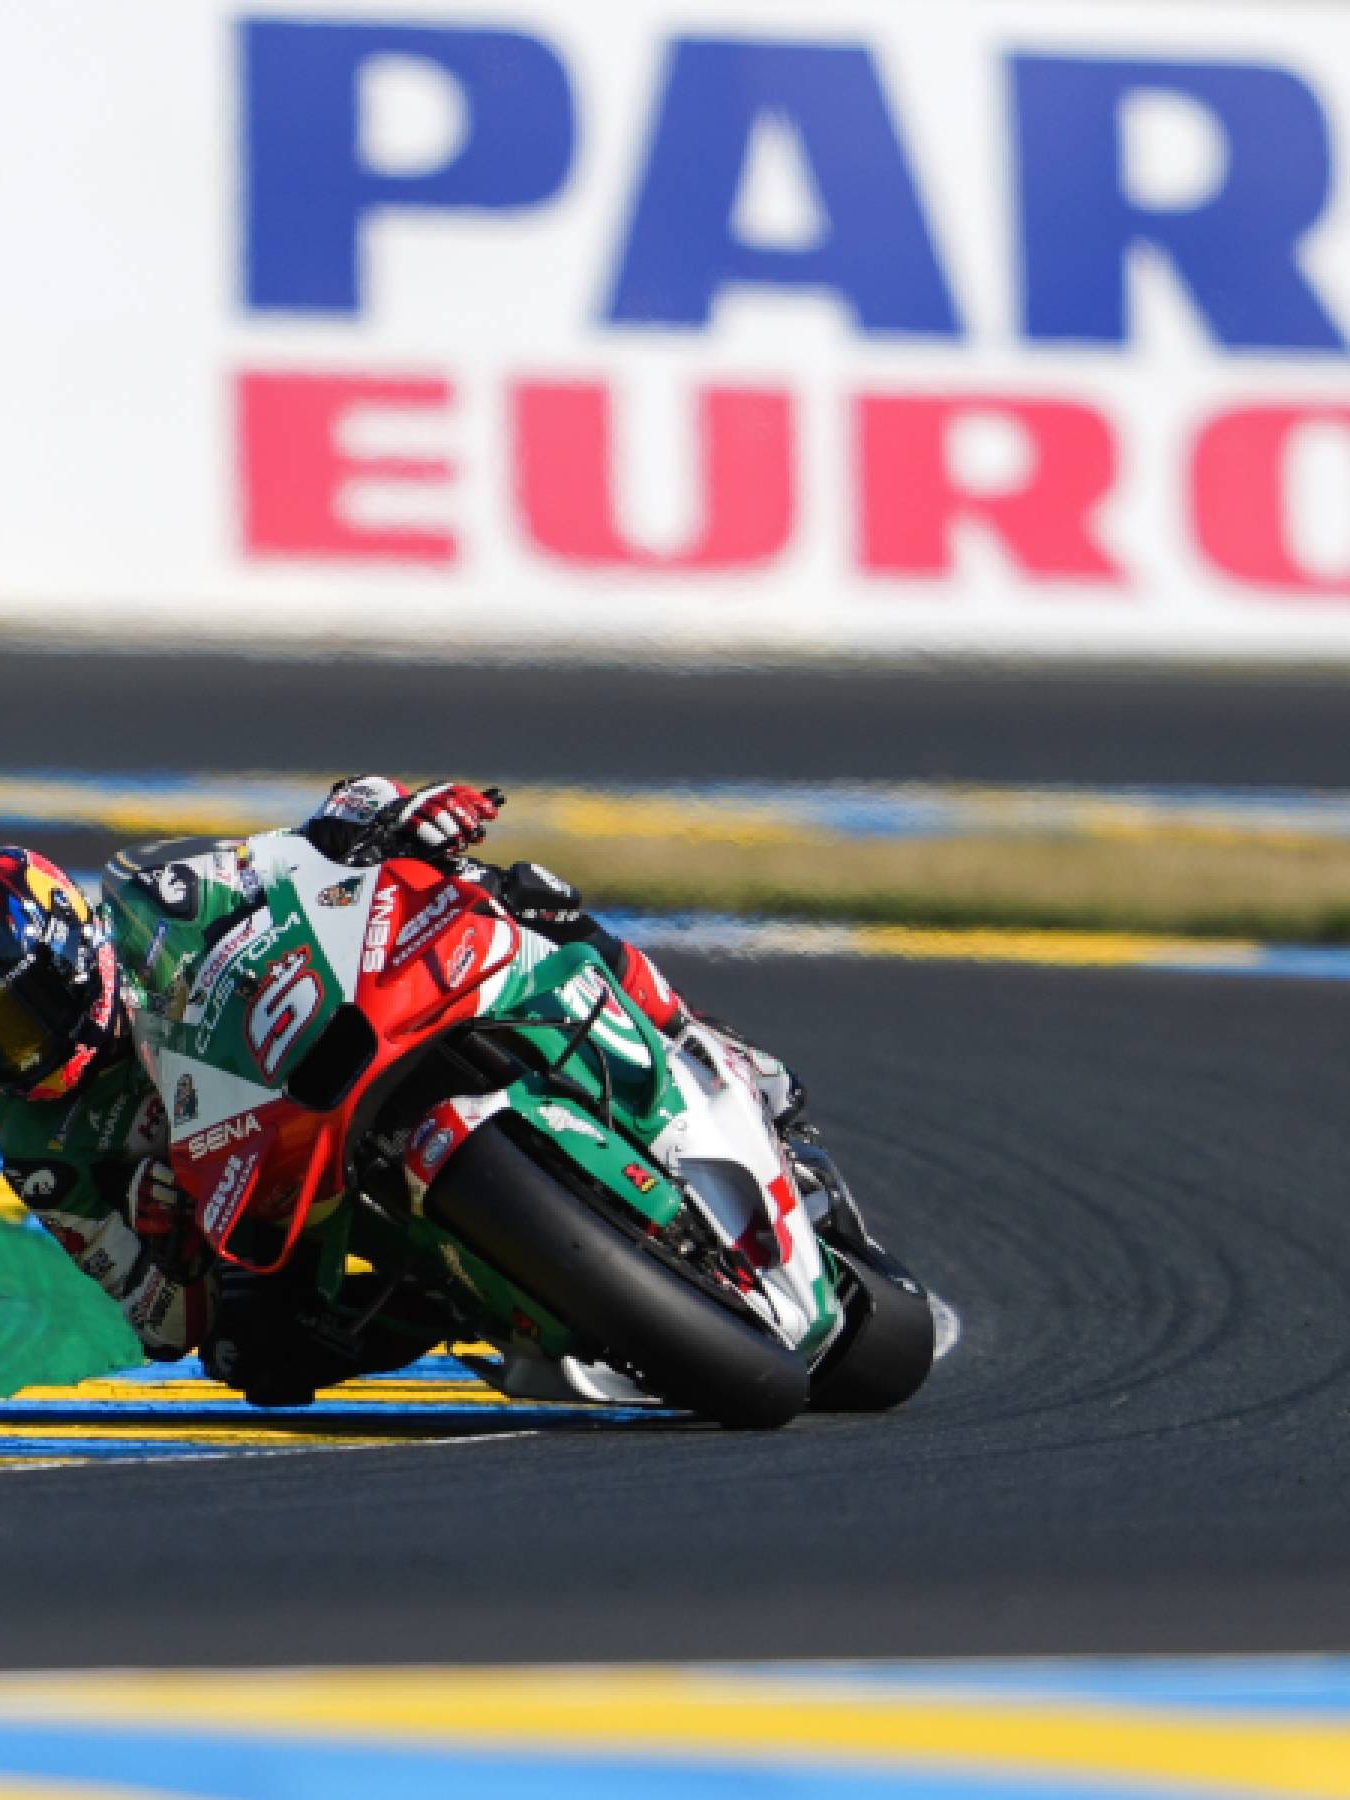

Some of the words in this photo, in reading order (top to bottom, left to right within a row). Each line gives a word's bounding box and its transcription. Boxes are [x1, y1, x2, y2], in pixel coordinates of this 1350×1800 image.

[236, 18, 1350, 352] PAR
[196, 910, 302, 1054] CUSTOM
[362, 884, 399, 973] SENA
[247, 944, 324, 1084] 5
[188, 1112, 262, 1162] SENA
